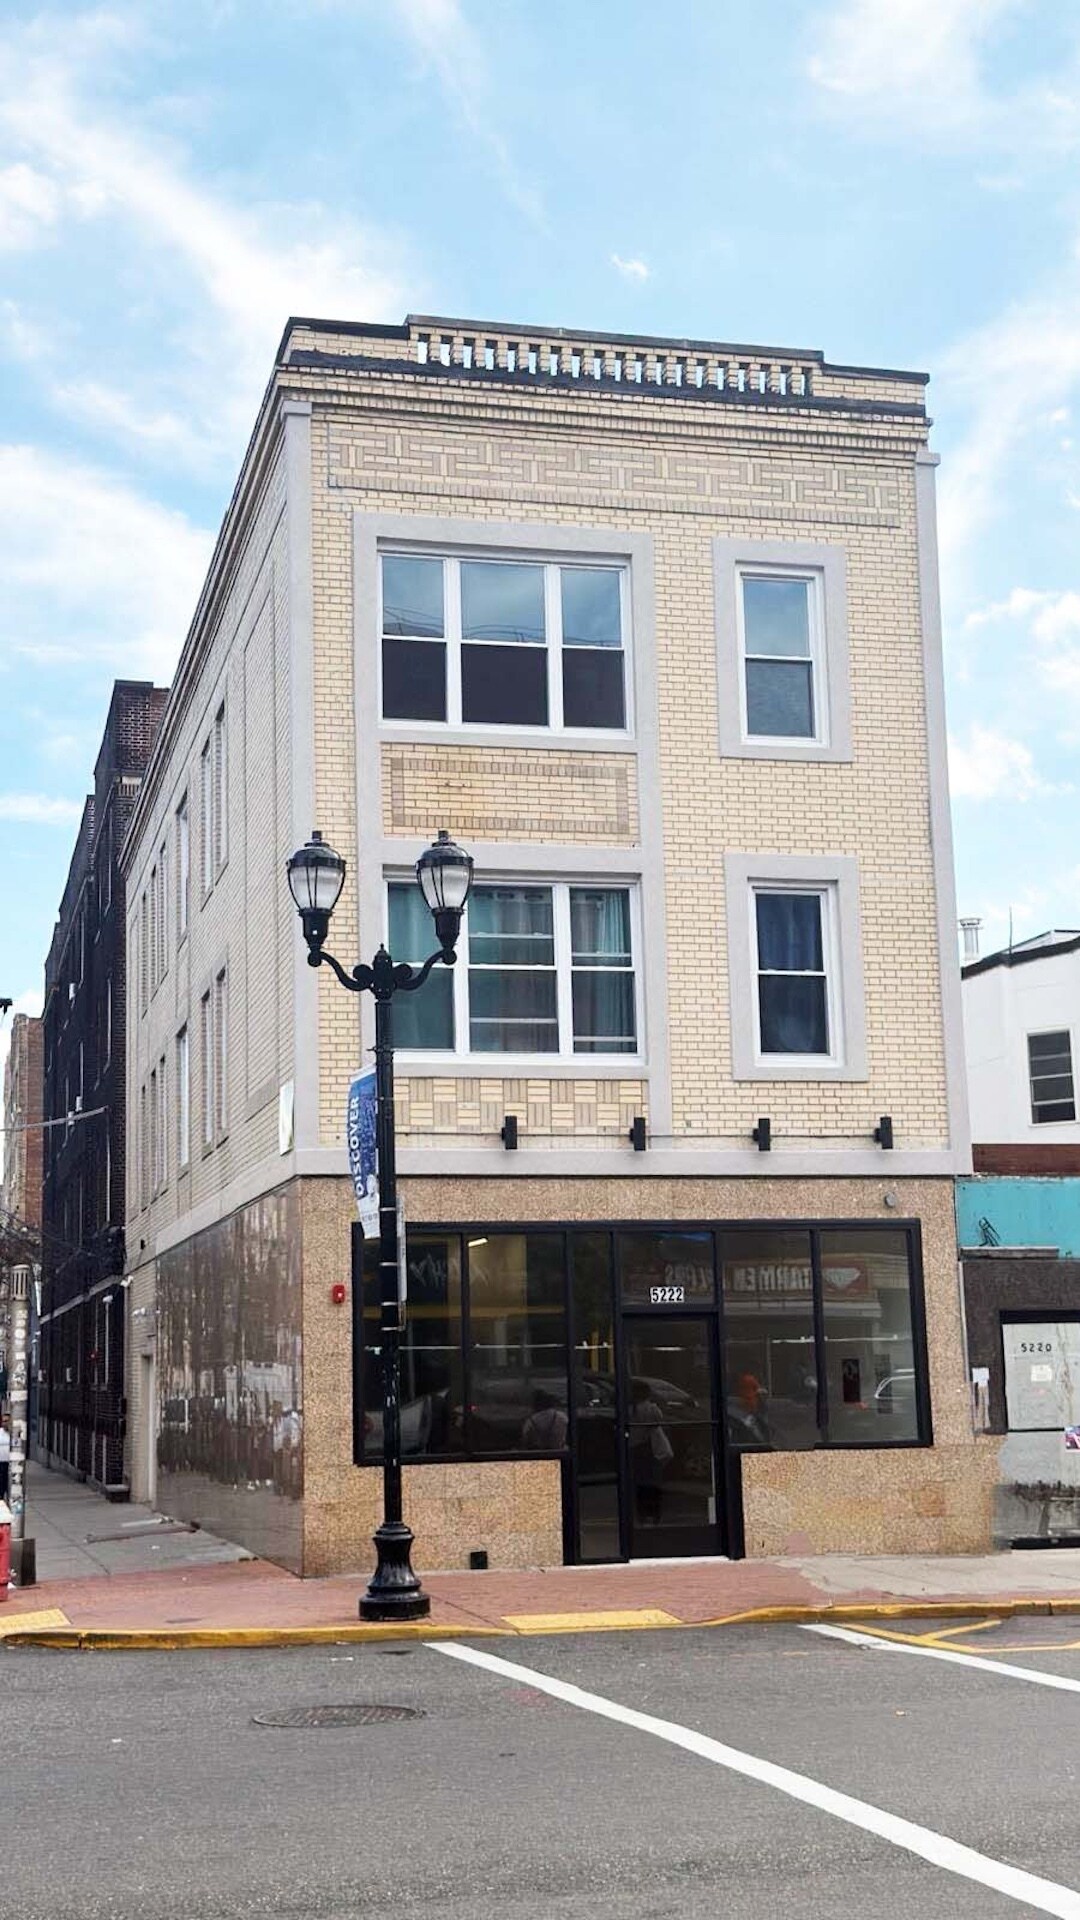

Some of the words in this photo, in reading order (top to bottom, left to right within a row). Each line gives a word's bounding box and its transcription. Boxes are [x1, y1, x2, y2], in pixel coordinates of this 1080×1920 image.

[349, 1096, 365, 1196] DISCOVER
[652, 1287, 683, 1302] 5222
[1020, 1342, 1052, 1353] 5220
